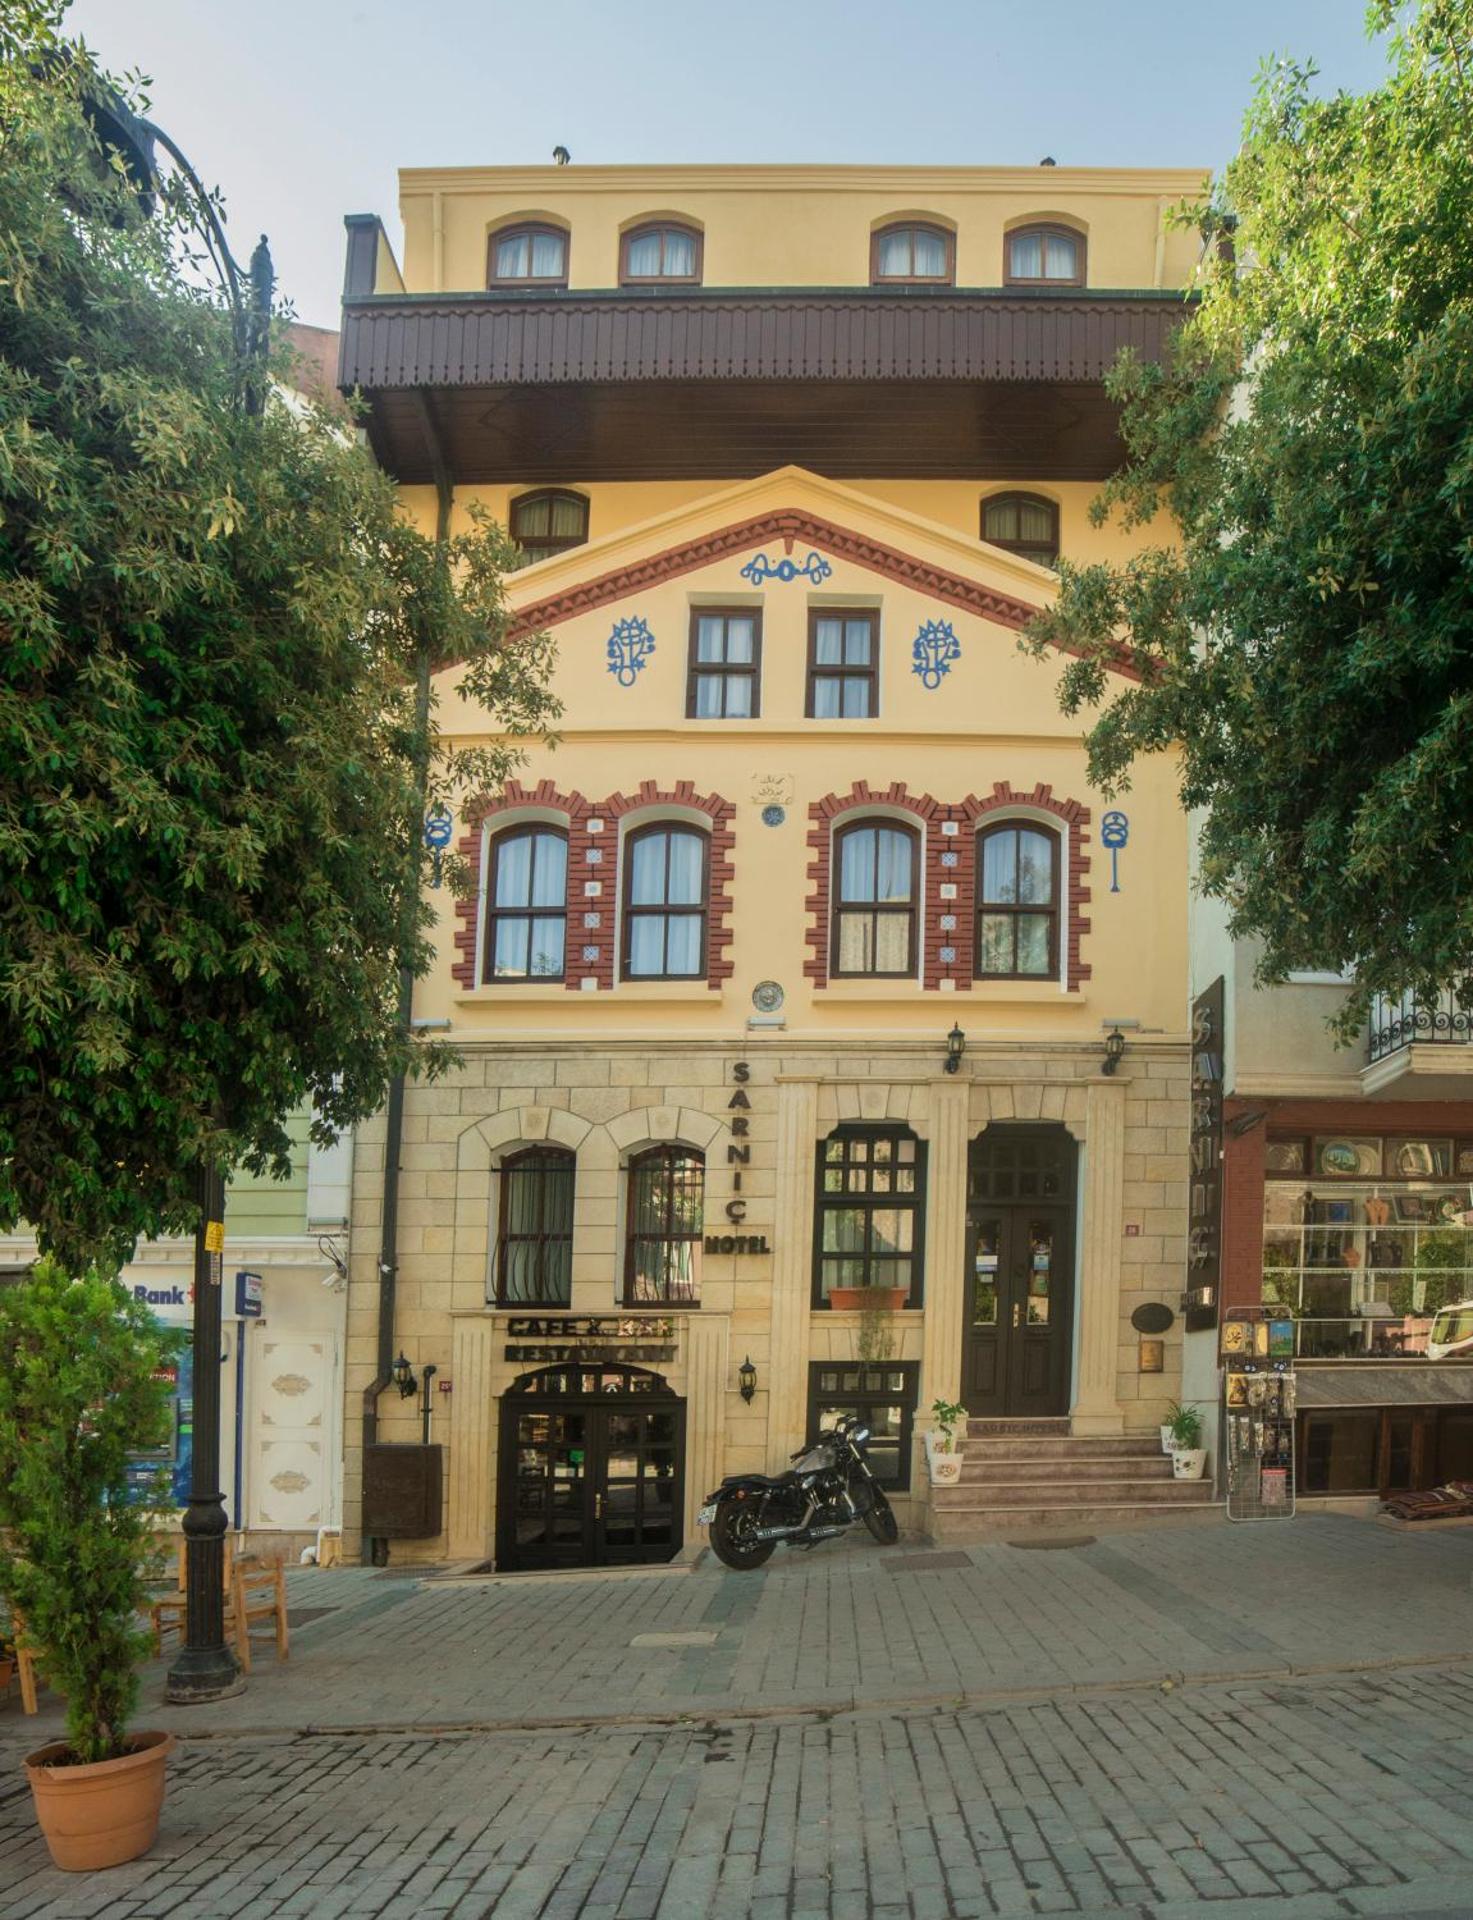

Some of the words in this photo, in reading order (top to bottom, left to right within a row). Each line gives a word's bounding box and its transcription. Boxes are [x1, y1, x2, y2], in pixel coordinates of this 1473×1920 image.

[725, 1061, 752, 1225] SARNIÇ
[704, 1235, 771, 1255] HOTEL
[508, 1317, 578, 1337] CAFE
